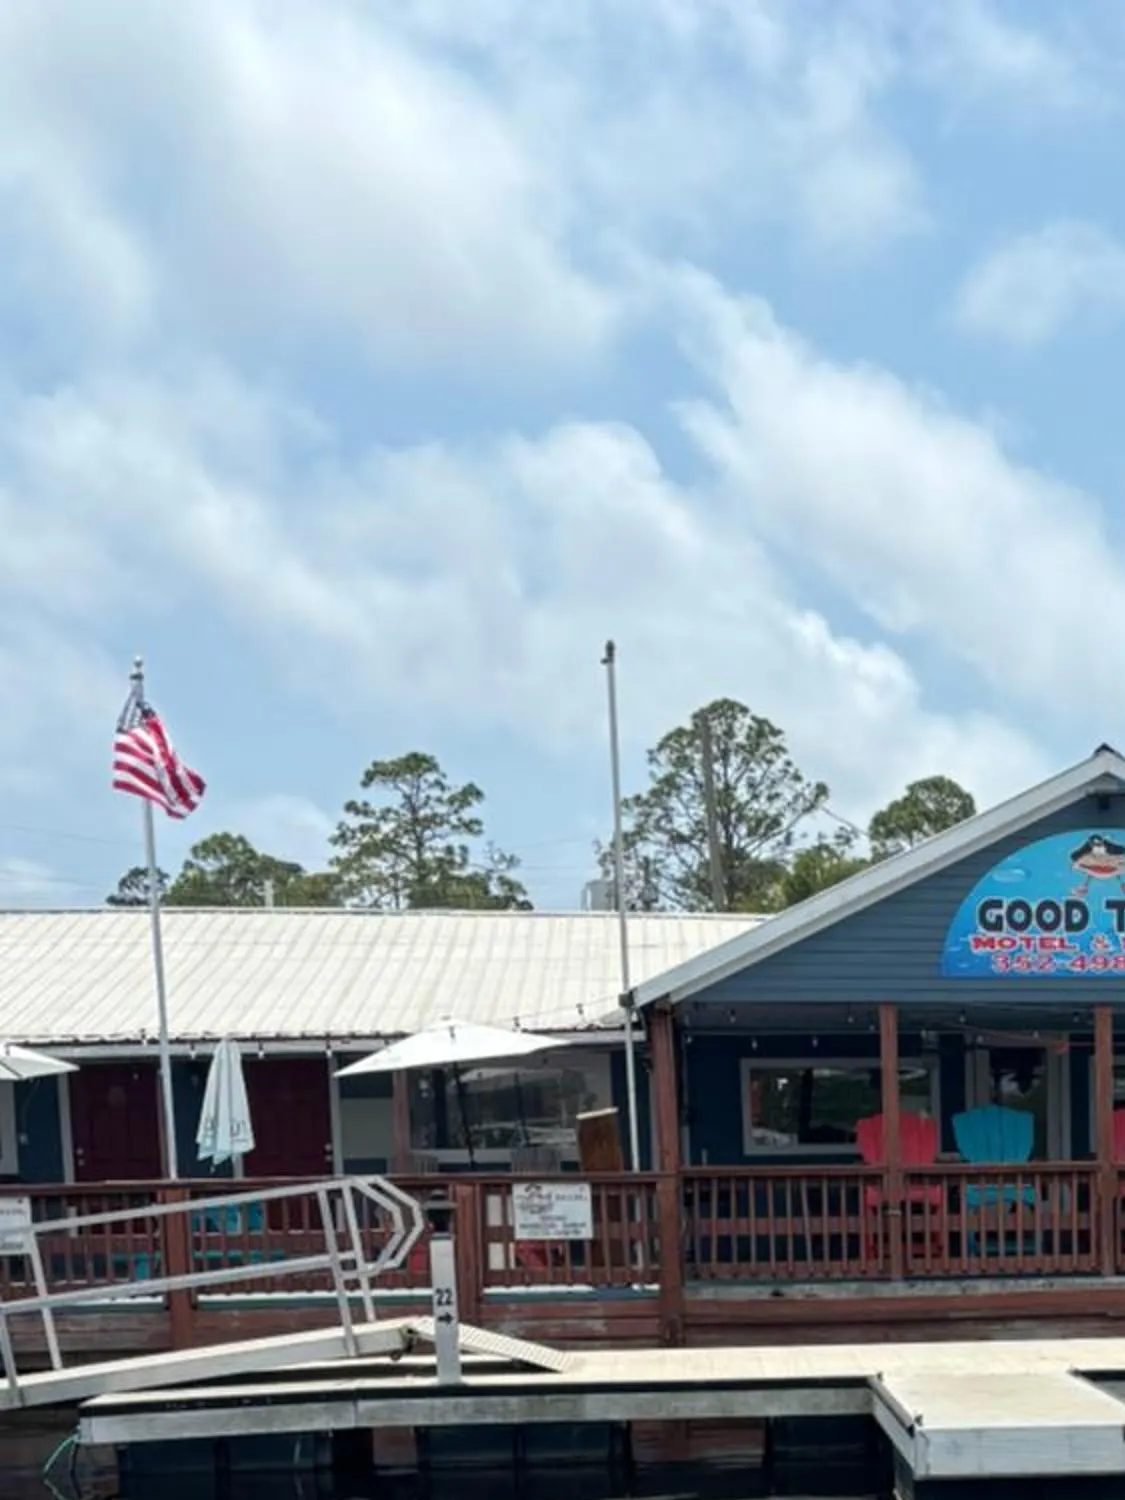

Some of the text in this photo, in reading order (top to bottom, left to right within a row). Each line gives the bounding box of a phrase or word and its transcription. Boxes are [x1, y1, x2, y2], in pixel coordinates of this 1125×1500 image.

[977, 898, 1090, 933] GOOD
[972, 935, 1077, 950] MOTEL
[1091, 935, 1109, 950] &
[435, 1287, 452, 1306] 22
